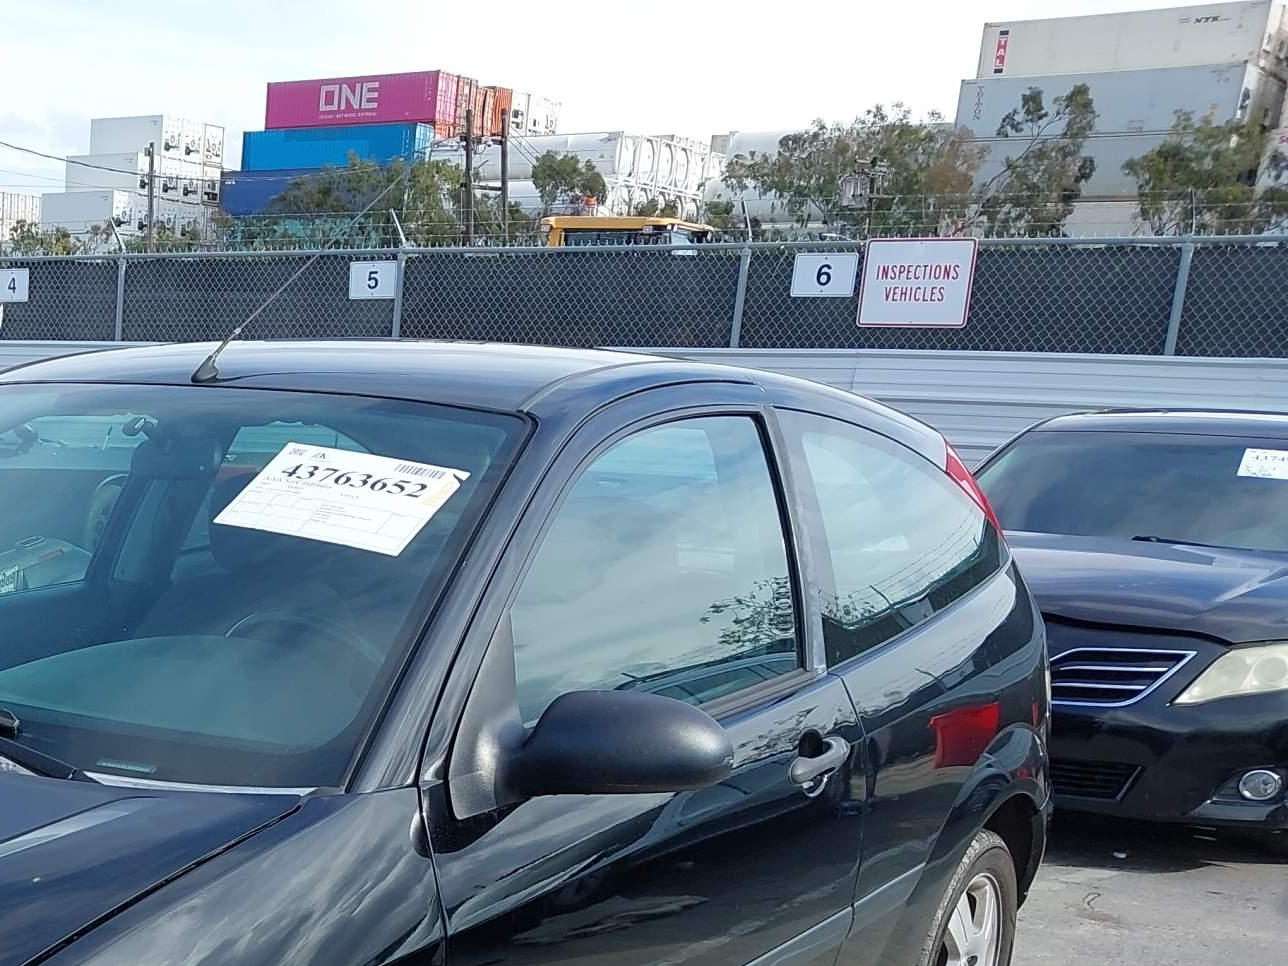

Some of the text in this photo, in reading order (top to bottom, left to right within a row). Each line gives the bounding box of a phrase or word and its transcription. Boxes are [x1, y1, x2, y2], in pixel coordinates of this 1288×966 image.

[319, 82, 380, 111] ONE
[367, 270, 379, 290] 5
[815, 263, 833, 287] 6
[876, 263, 961, 281] INSPECTIONS
[7, 277, 17, 294] 4
[884, 286, 945, 302] VEHICLES
[281, 463, 429, 498] 43763652
